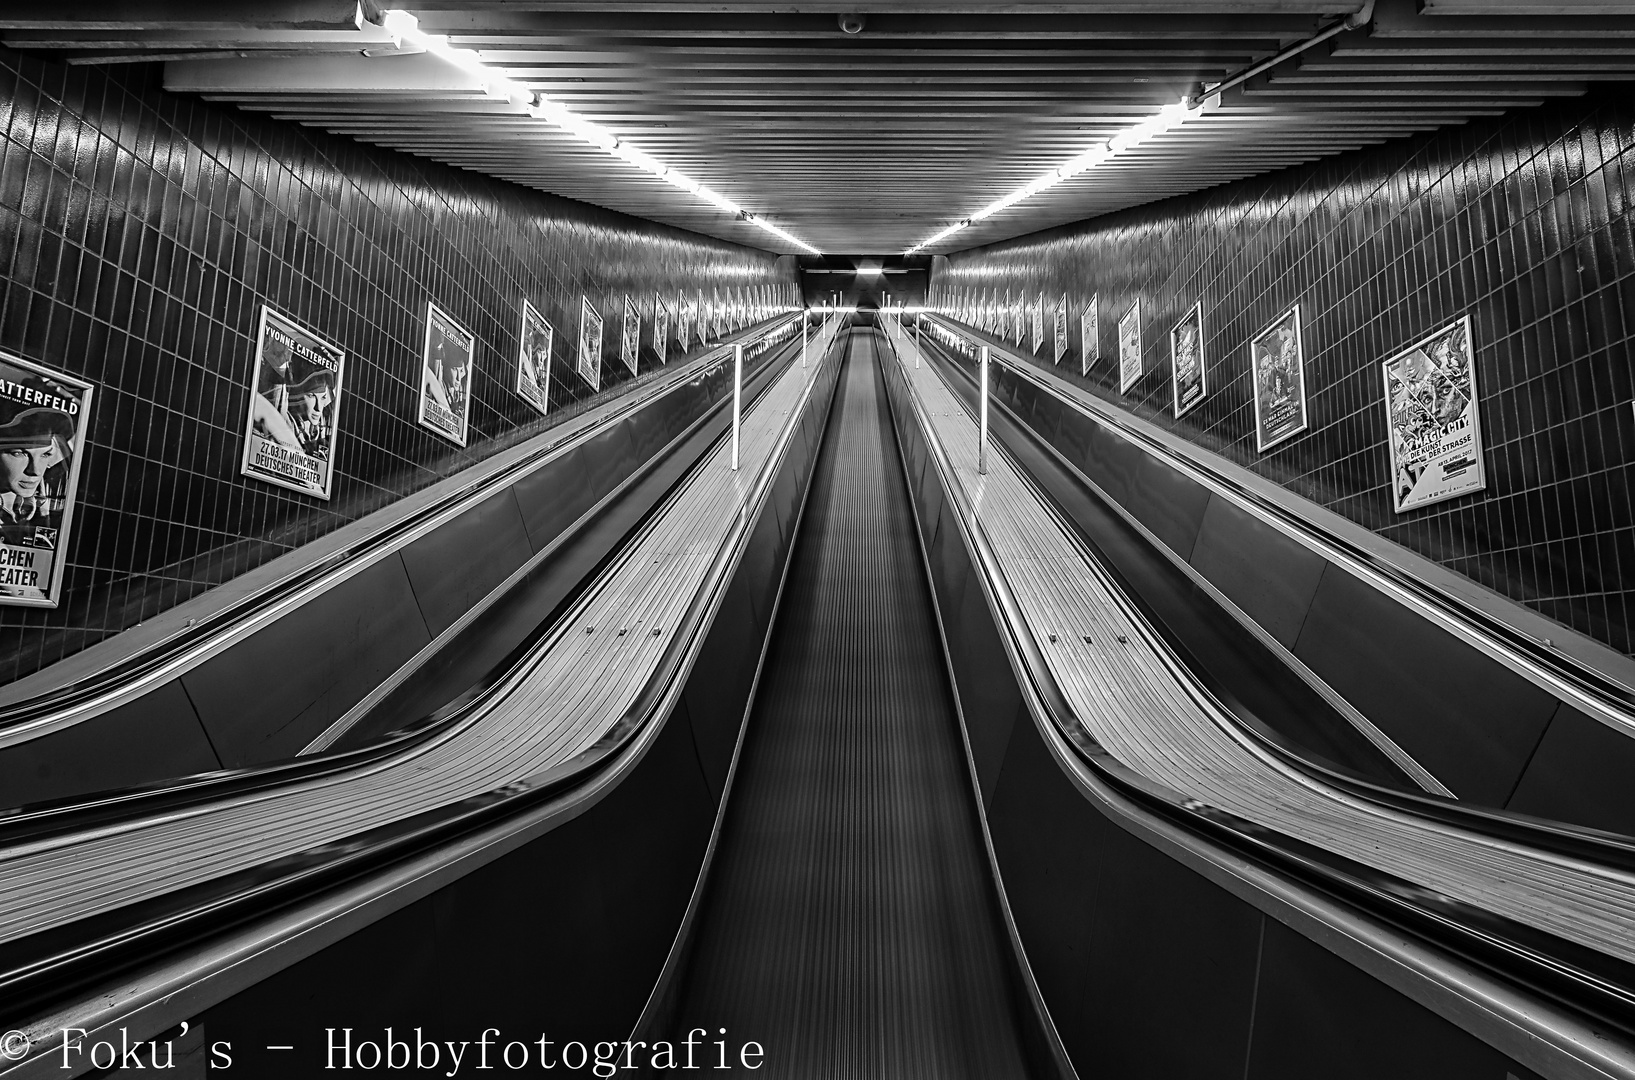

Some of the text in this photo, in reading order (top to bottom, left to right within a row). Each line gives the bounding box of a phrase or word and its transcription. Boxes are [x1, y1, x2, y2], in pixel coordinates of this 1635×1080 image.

[265, 325, 295, 350] YVONNE
[296, 343, 338, 373] CATTERFELD
[1414, 414, 1469, 449] MAGIC CITY
[1428, 433, 1472, 459] DER STRASSE
[260, 441, 319, 472] 27.03.17 MÜNCHEN
[1410, 439, 1442, 460] DIE KUNST
[255, 453, 293, 476] DEUTSCHES
[294, 466, 321, 485] THEATER
